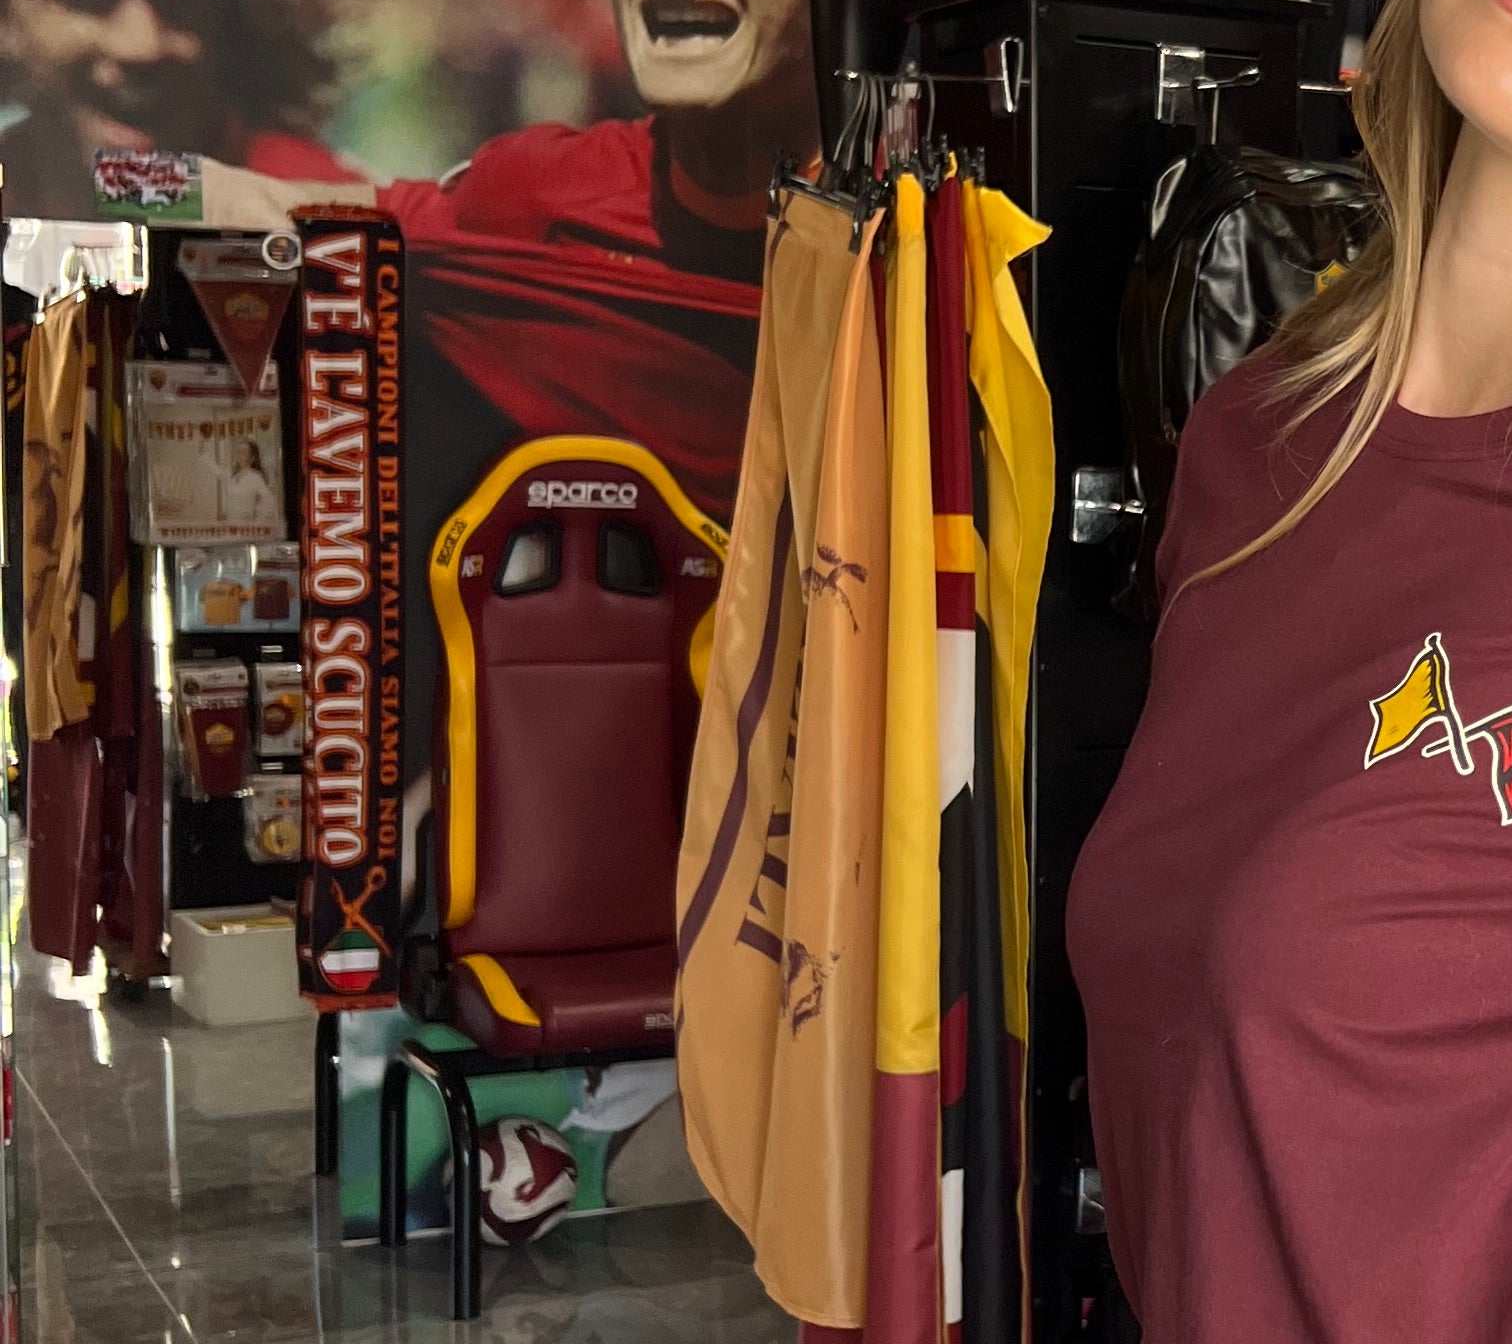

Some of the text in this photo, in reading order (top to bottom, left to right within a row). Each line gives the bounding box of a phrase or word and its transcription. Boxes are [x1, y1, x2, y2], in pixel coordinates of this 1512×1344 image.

[376, 268, 400, 444] CAMPIONI
[308, 353, 368, 603] L'AVEMO
[527, 480, 639, 509] sparco
[312, 620, 368, 866] SCUCITO
[379, 675, 401, 786] SIAMO
[378, 797, 398, 860] NOI
